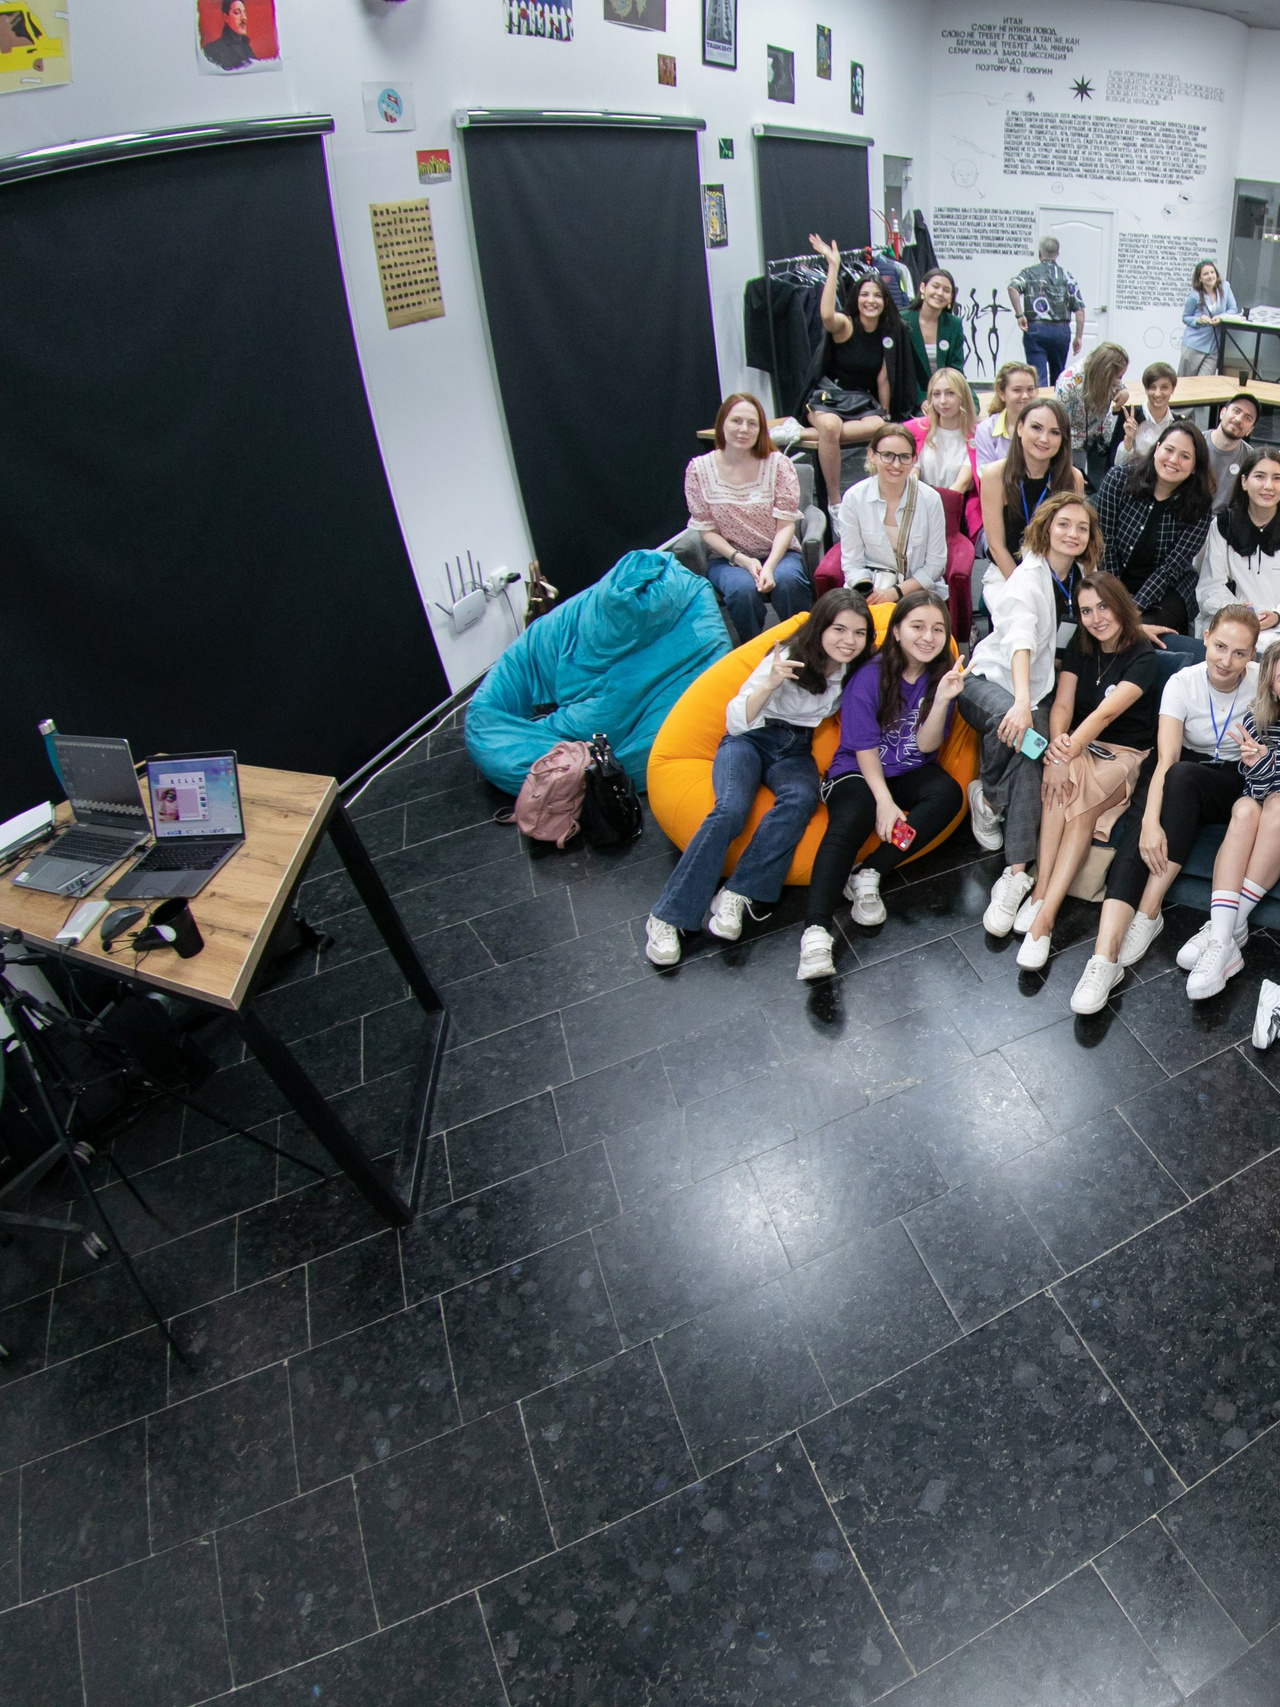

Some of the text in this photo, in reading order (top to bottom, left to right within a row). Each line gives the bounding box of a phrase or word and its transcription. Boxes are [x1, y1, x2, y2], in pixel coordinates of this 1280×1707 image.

[971, 23, 997, 31] СЛОВУ
[1008, 25, 1030, 33] НУЖЕН
[941, 30, 965, 38] СЛОВО
[978, 32, 1005, 40] ТРЕБУЕТ
[1008, 34, 1037, 42] ПОВОДА
[1040, 35, 1052, 43] ТАК
[1001, 41, 1028, 49] ТРЕБУЕТ
[976, 63, 1007, 72] ПОЭТОМУ
[1023, 67, 1053, 75] ГОВОРИМ
